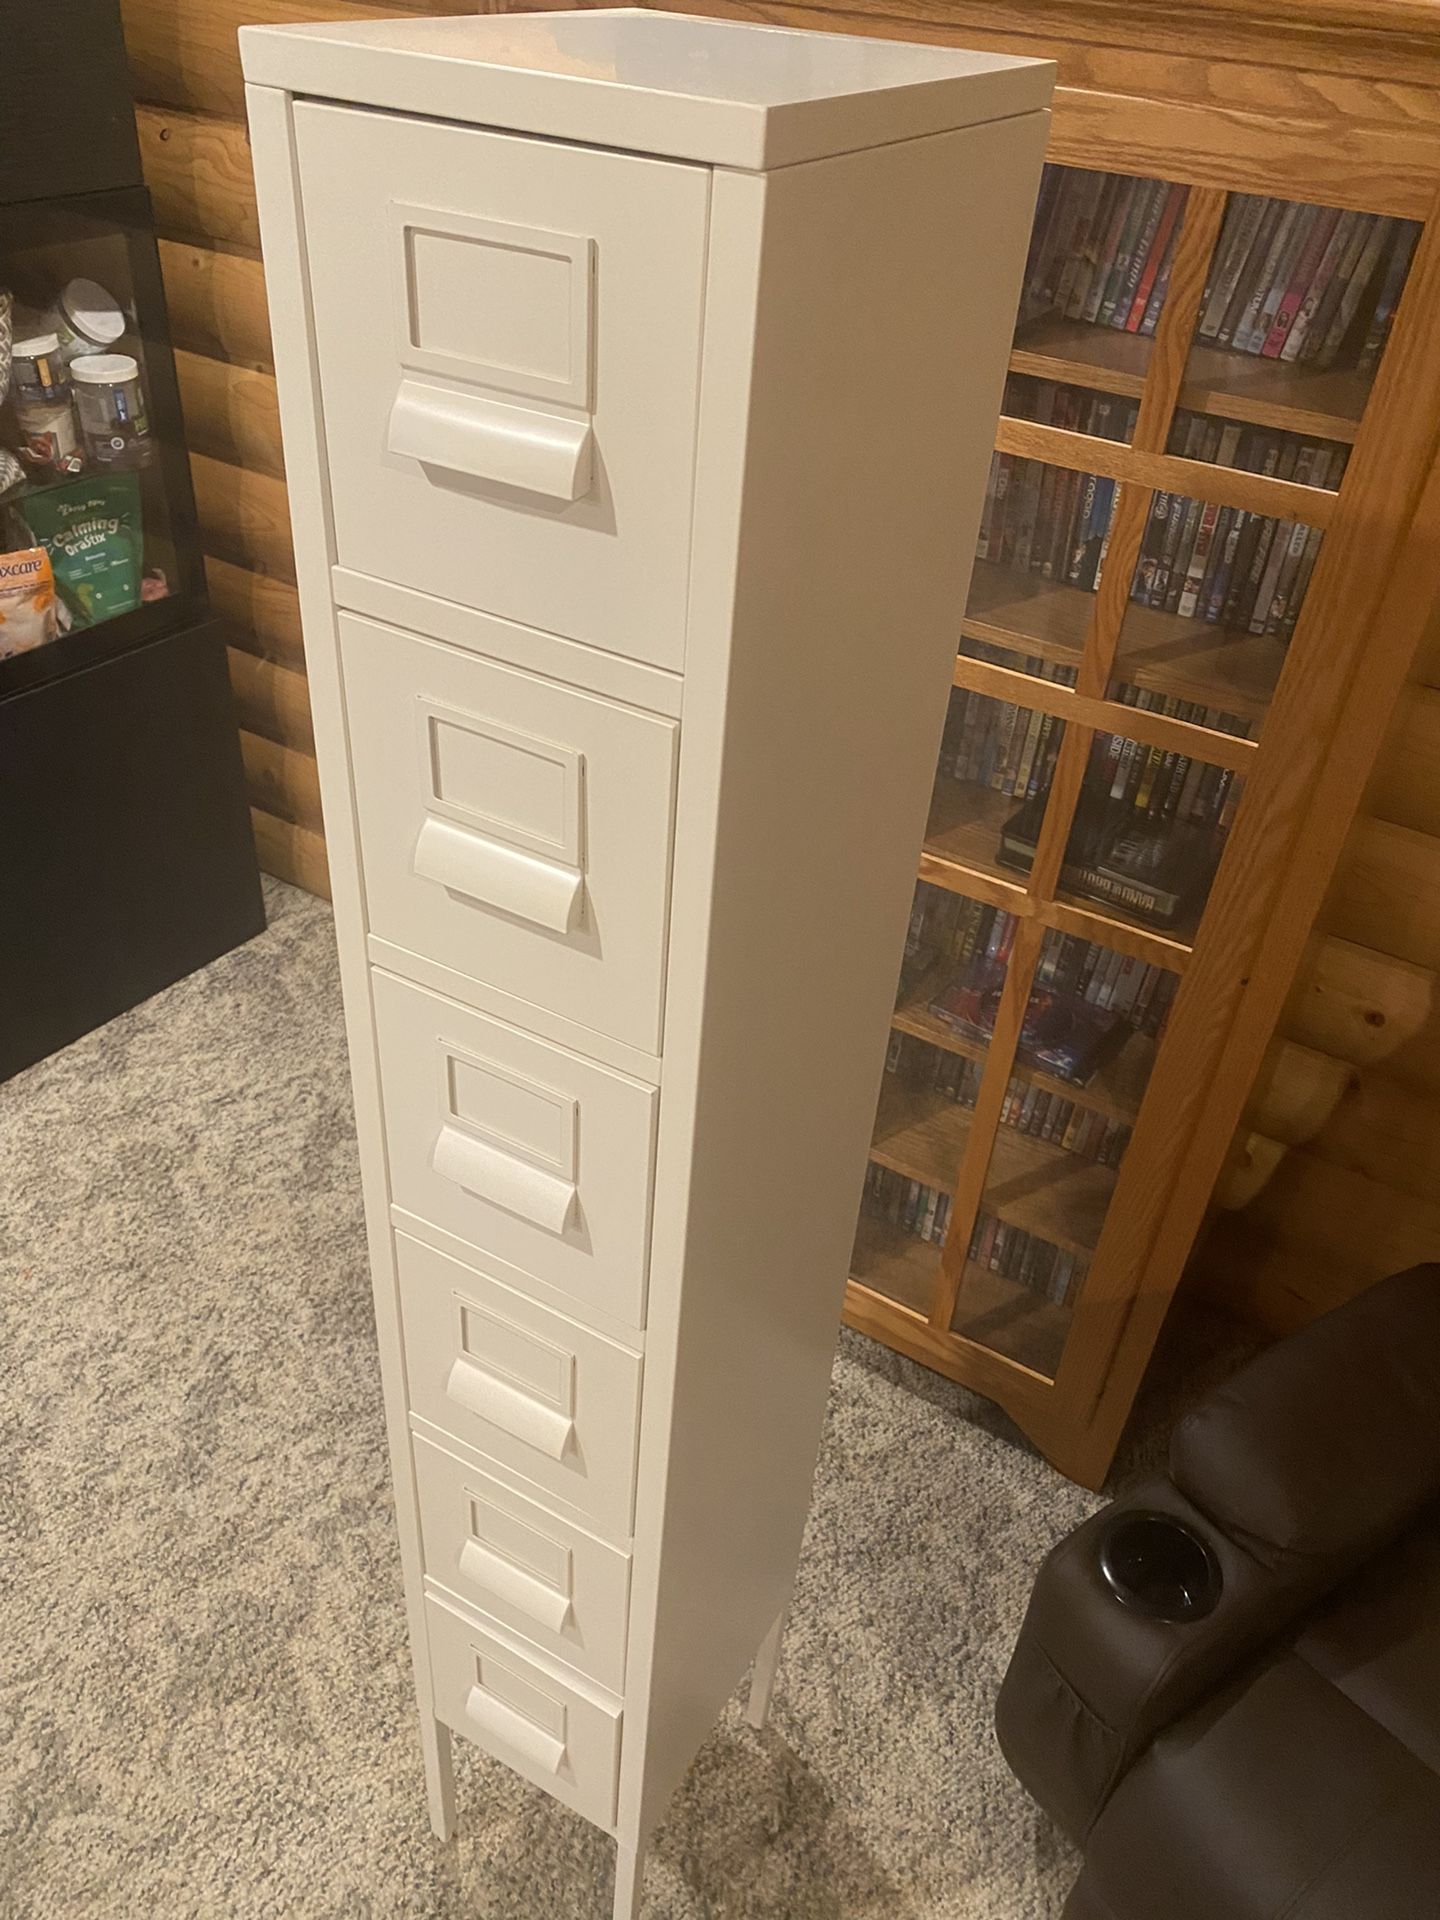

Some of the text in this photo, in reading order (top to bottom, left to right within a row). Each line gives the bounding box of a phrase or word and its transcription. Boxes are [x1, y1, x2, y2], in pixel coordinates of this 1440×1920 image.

[1083, 476, 1097, 519] ragon
[52, 517, 120, 549] Calming
[64, 532, 107, 557] OraStix
[1108, 734, 1124, 761] SIDE
